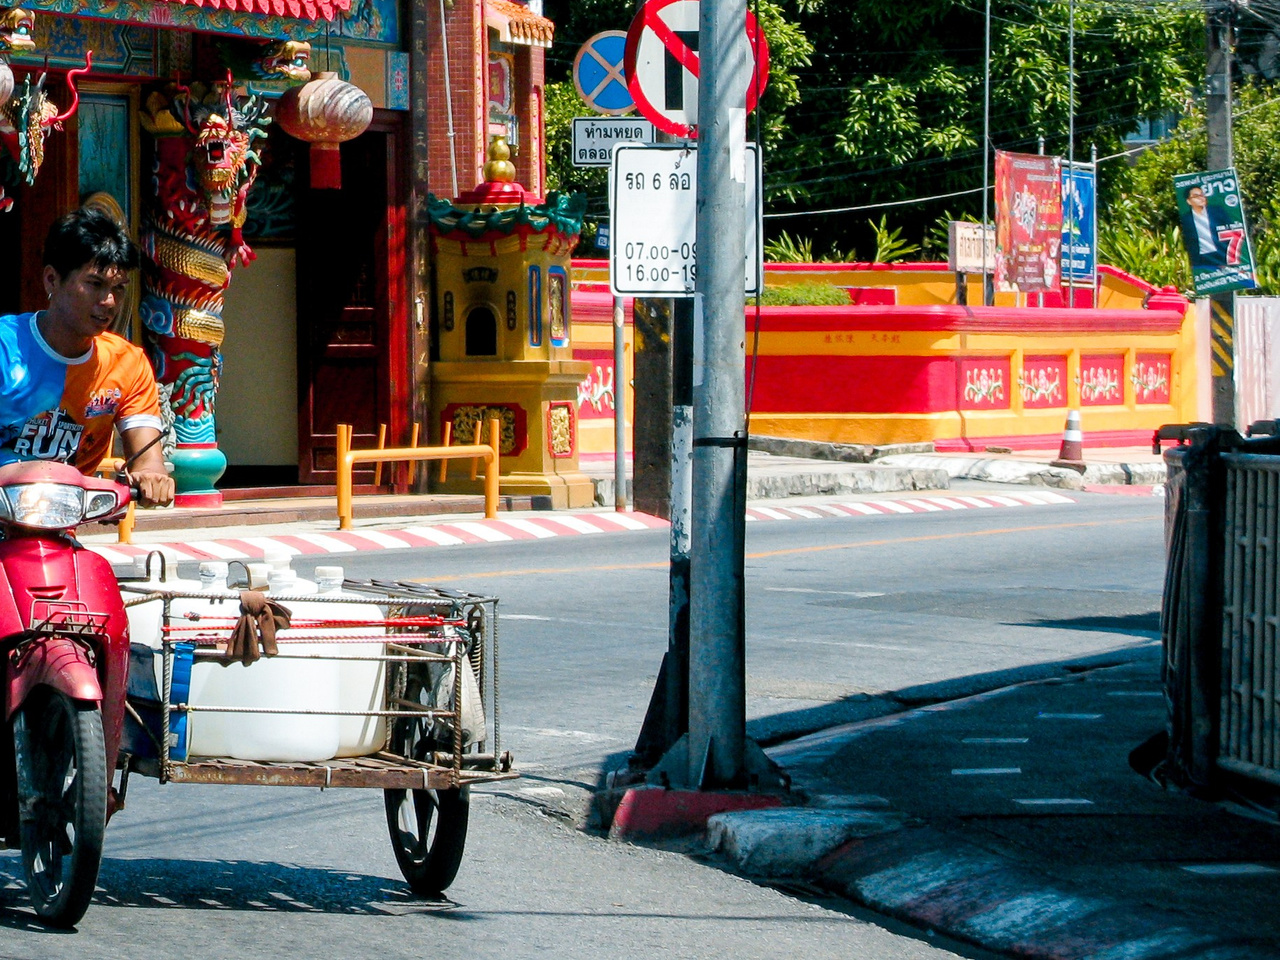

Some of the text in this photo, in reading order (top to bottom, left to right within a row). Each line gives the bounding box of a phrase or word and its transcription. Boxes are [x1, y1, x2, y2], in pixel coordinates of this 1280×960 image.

[585, 122, 643, 142] ห้ามหยด
[652, 172, 661, 190] 6
[1217, 228, 1246, 265] 7
[20, 424, 82, 458] FUN
